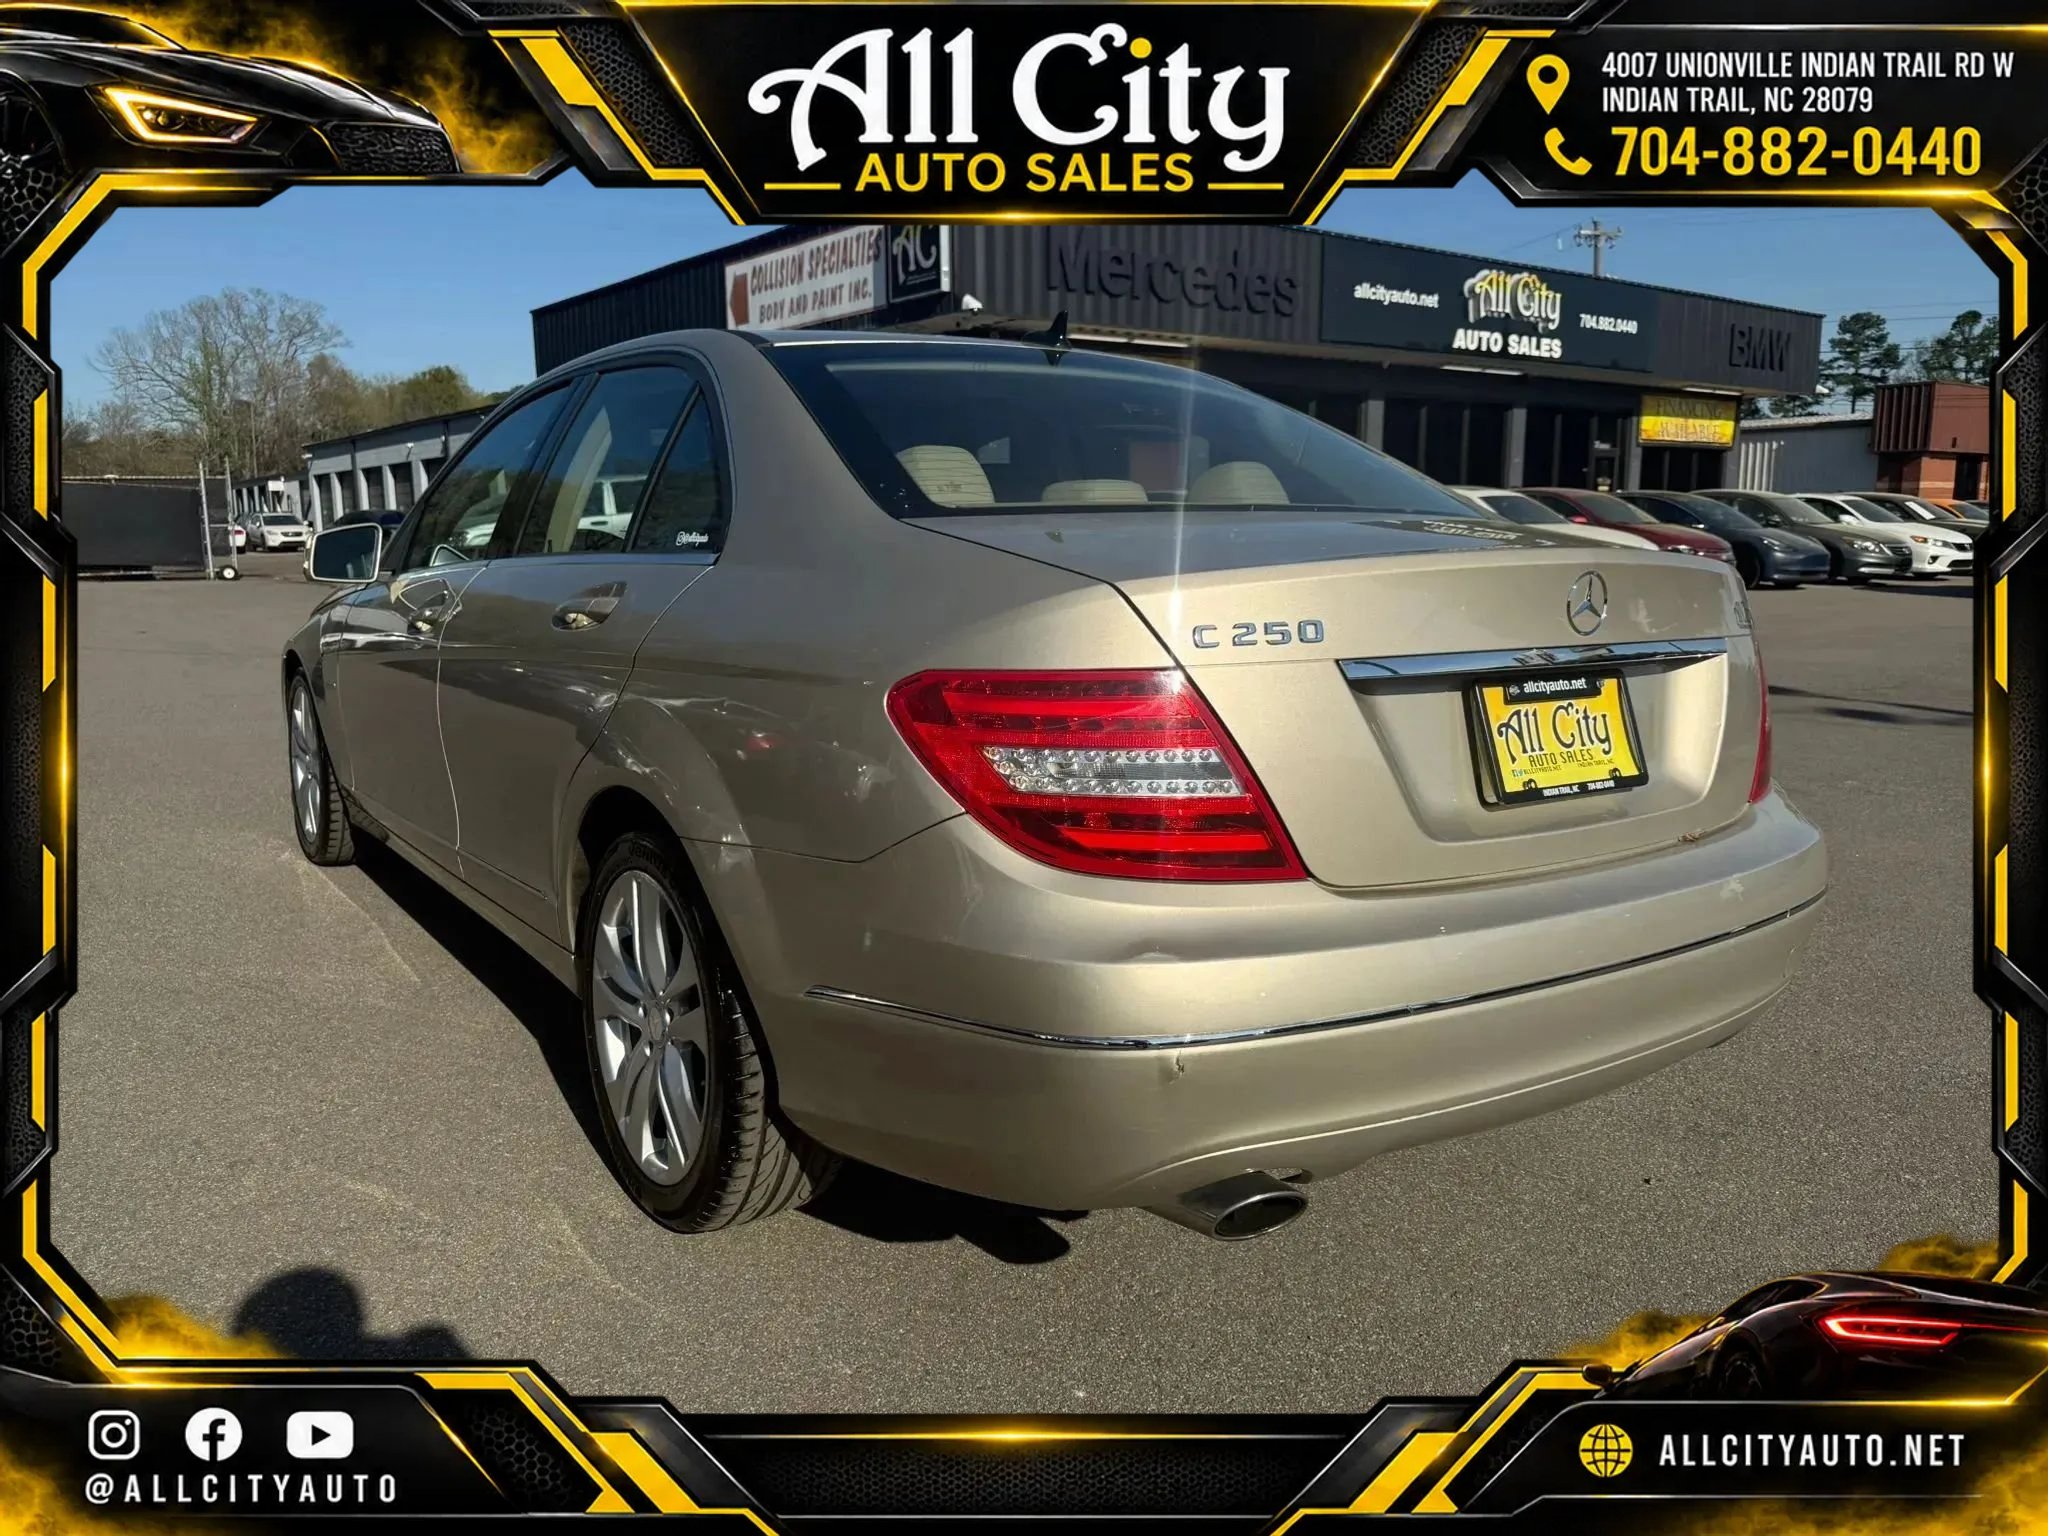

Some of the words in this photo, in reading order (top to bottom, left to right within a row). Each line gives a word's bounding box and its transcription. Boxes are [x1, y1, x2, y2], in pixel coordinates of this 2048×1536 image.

[750, 249, 805, 297] COLLISION
[808, 226, 883, 280] SPECIALTIES
[1046, 225, 1299, 318] Mercedes
[758, 302, 785, 323] BODY
[788, 297, 809, 317] AND
[812, 284, 844, 309] PAINT
[848, 278, 873, 302] INC.
[1353, 282, 1440, 309] allcityauto.net
[1462, 268, 1513, 325] All
[1510, 271, 1563, 333] City
[1452, 328, 1502, 354] AUTO
[1508, 333, 1563, 360] SALES
[1728, 322, 1792, 372] BMW
[1192, 624, 1220, 649] C
[1232, 619, 1325, 647] 250
[1523, 677, 1587, 695] allcityauto.net
[1497, 707, 1545, 765] All
[1551, 701, 1612, 756] City
[1528, 752, 1558, 767] AUTO
[1560, 748, 1595, 764] SALES
